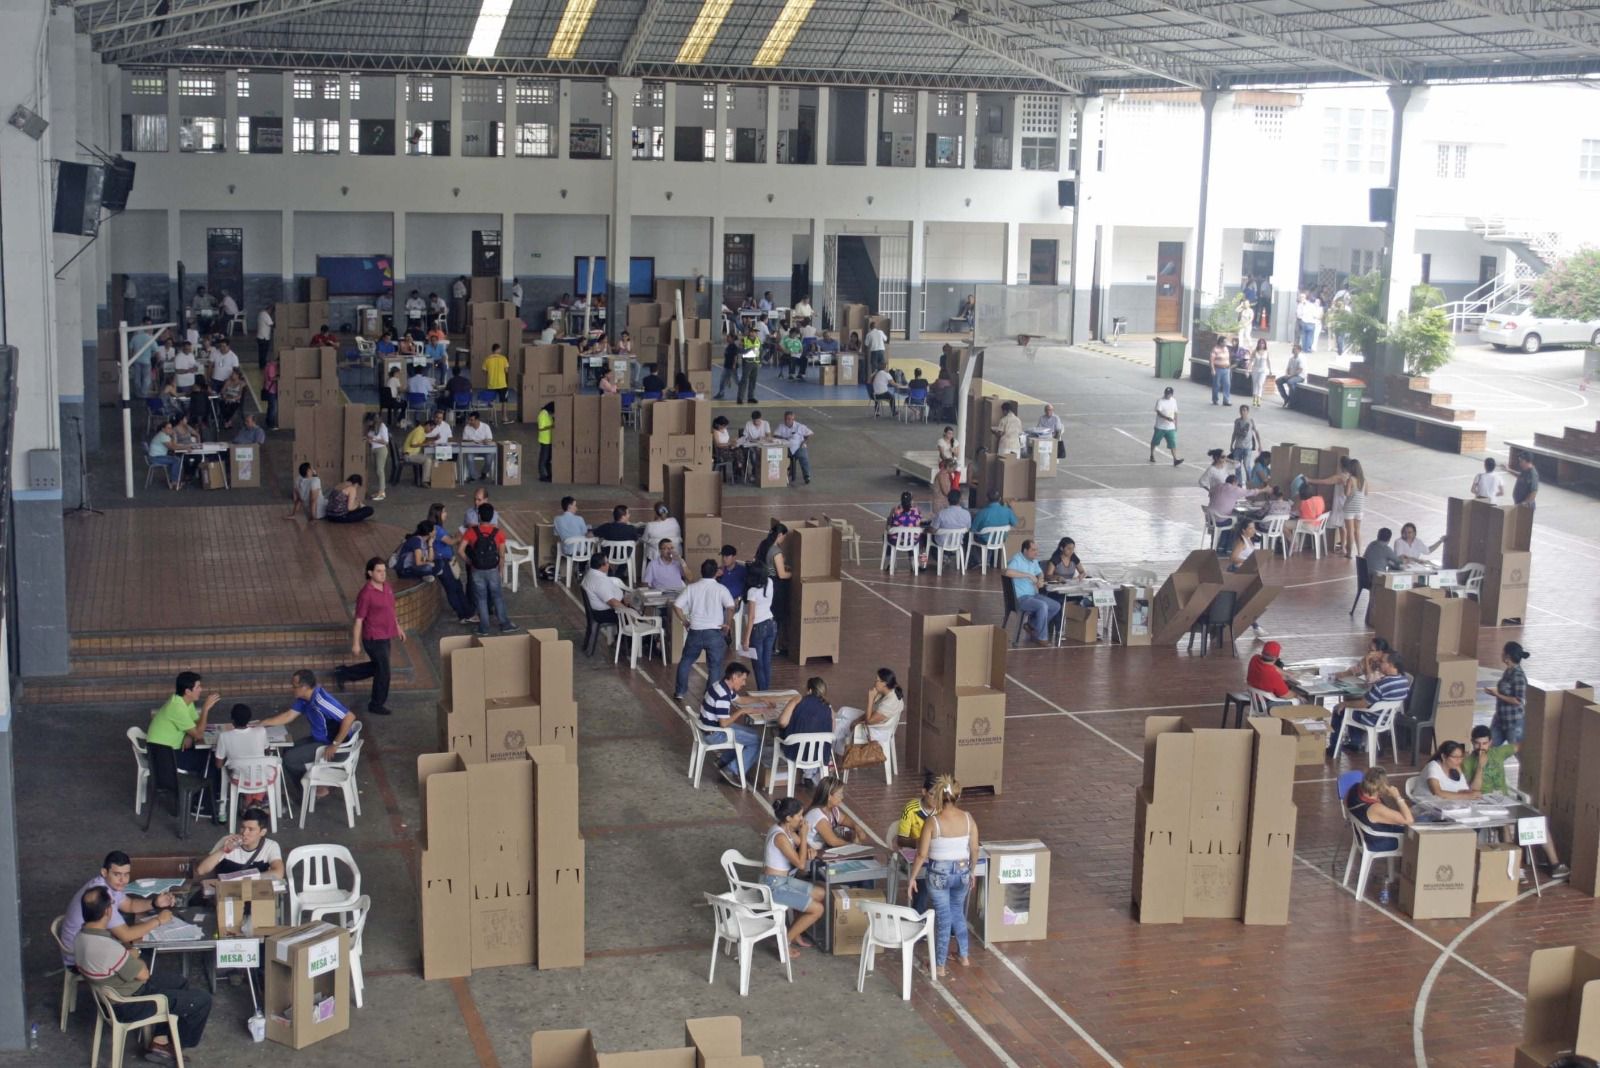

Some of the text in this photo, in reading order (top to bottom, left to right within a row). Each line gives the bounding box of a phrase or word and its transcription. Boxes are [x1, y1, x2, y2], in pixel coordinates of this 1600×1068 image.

[1520, 831, 1534, 840] MESA
[1002, 868, 1033, 878] MESA 33
[220, 953, 256, 963] MESA 34
[310, 953, 337, 972] MESA 34
